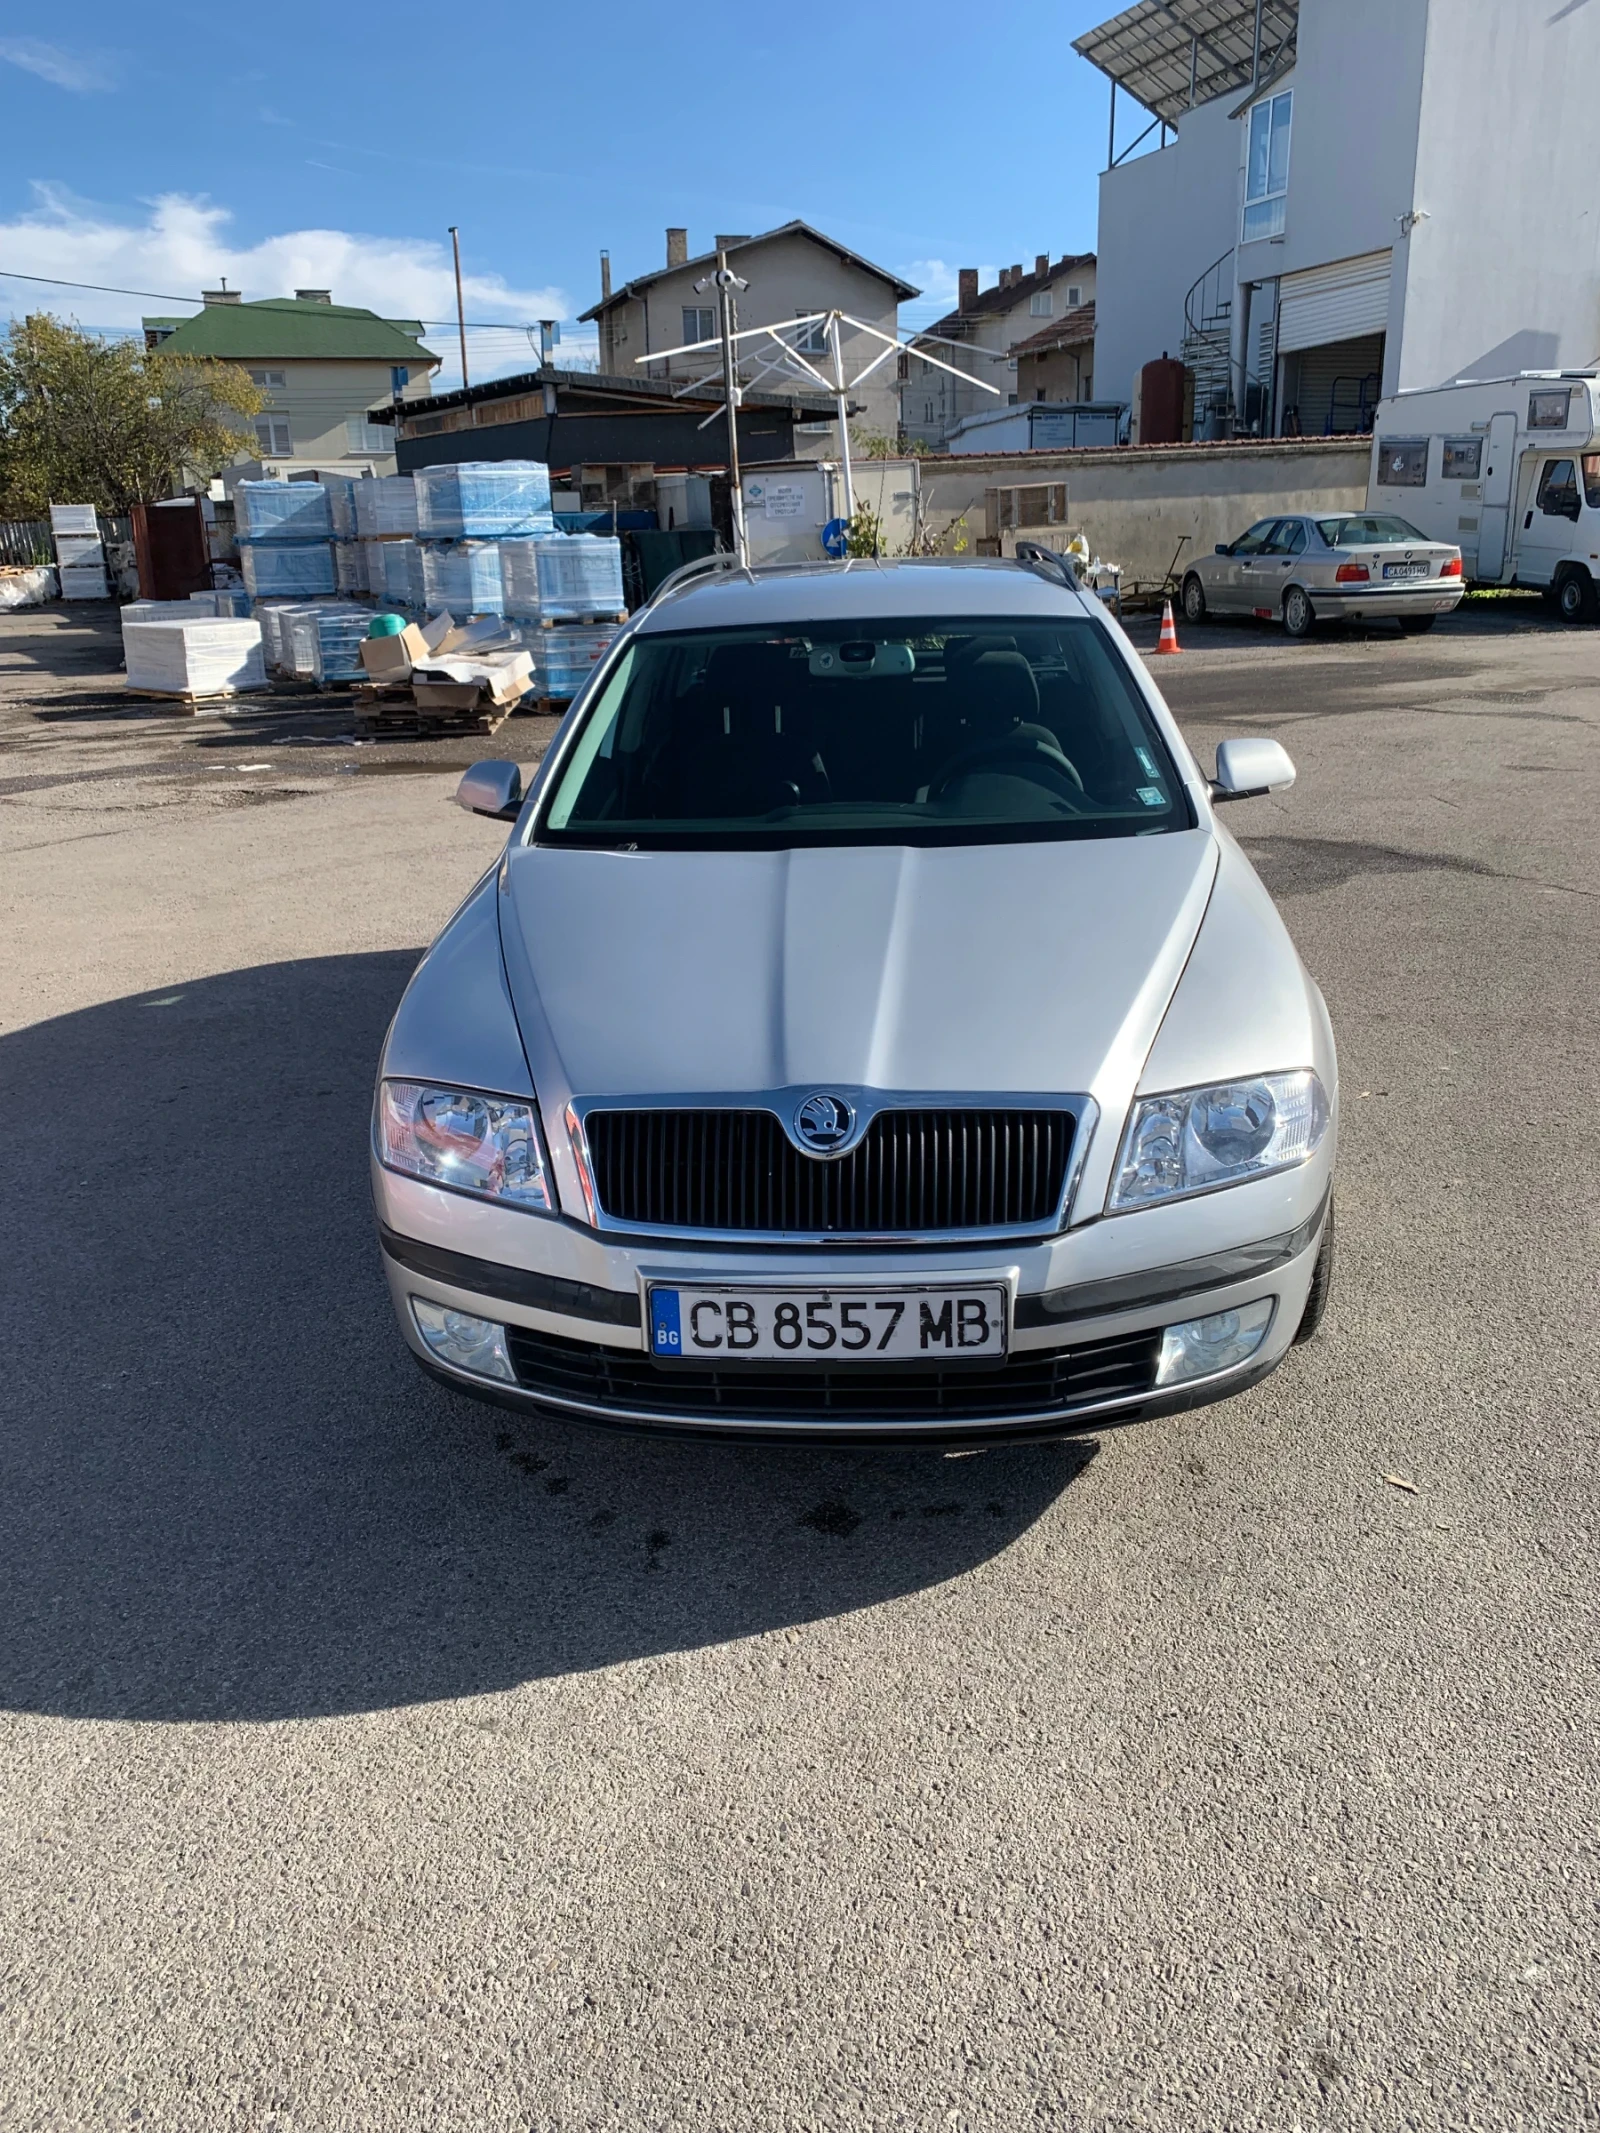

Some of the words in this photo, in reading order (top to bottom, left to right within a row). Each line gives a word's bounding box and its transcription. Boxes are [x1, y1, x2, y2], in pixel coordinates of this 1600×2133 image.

[1399, 566, 1416, 576] 0491
[690, 1300, 759, 1349] CB
[773, 1302, 905, 1350] 8557
[919, 1299, 990, 1349] MB
[657, 1330, 679, 1345] BG
